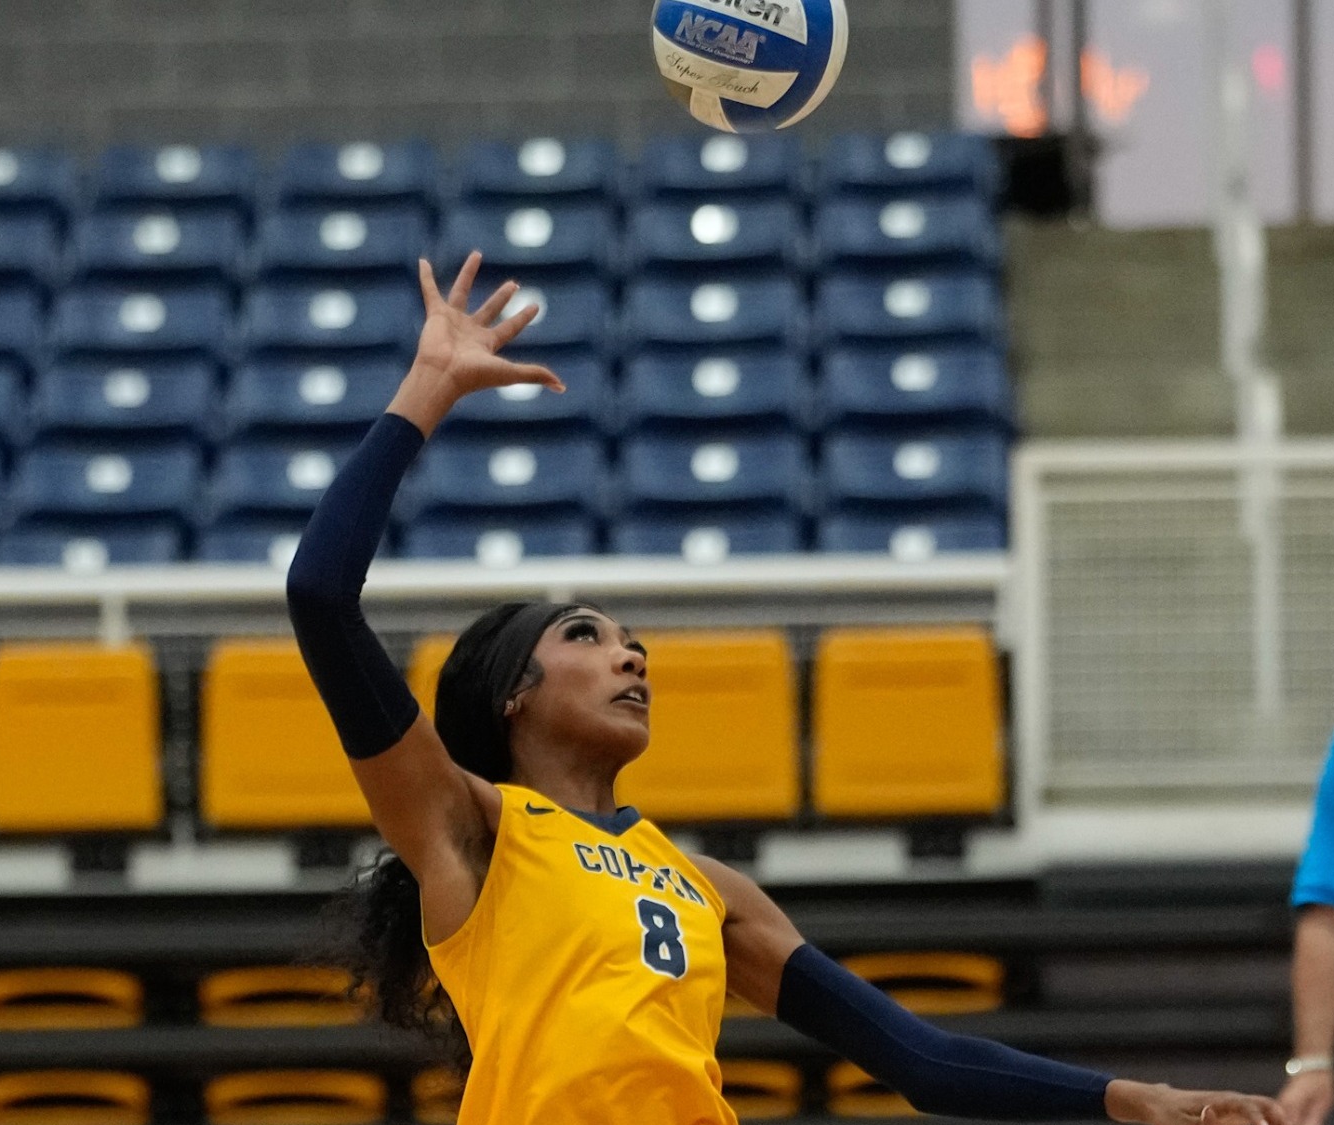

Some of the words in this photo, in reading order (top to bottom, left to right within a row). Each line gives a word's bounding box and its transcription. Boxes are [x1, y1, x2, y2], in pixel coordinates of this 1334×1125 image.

[674, 10, 760, 61] NCAA
[666, 52, 704, 80] Super
[709, 73, 760, 94] Touch
[635, 896, 689, 980] 8
